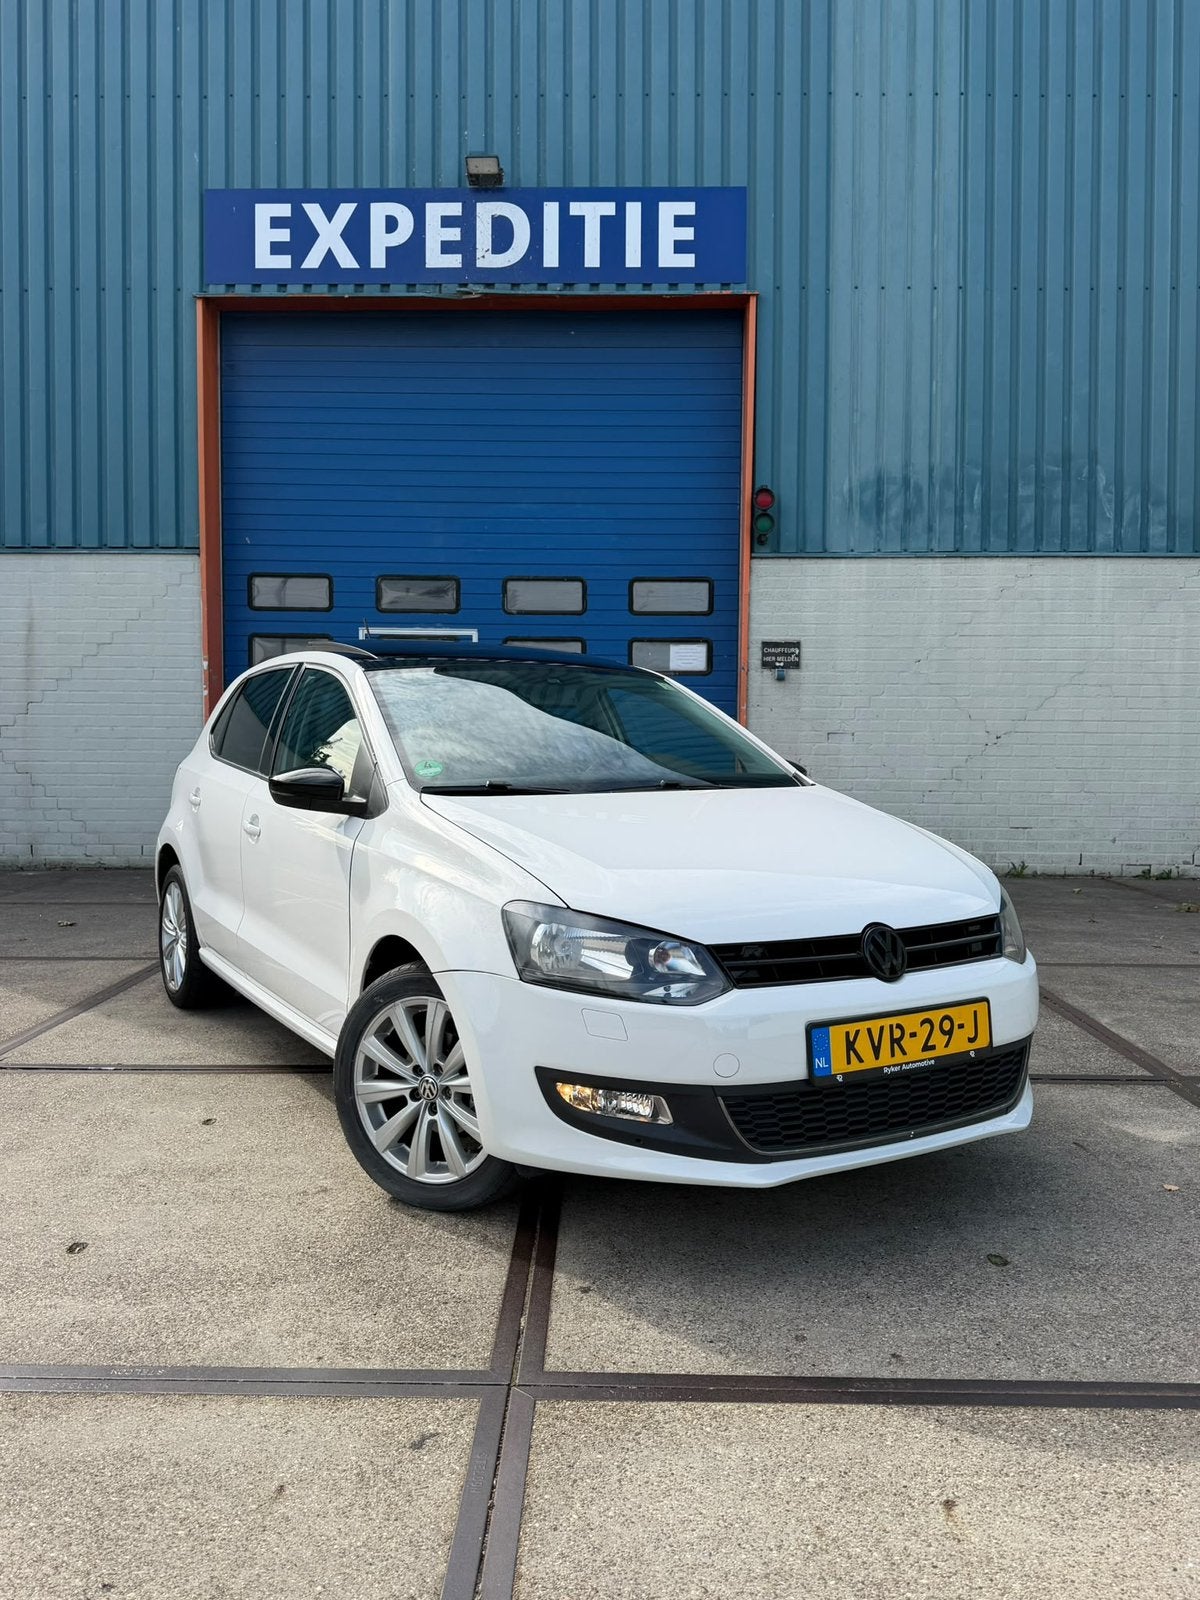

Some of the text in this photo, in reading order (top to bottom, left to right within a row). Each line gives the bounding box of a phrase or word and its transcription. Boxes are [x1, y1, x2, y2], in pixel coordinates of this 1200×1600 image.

[254, 201, 696, 269] EXPEDITIE
[844, 1010, 978, 1066] KVR-29-J
[815, 1057, 829, 1069] NL
[883, 1059, 935, 1075] Ryker Automotive
